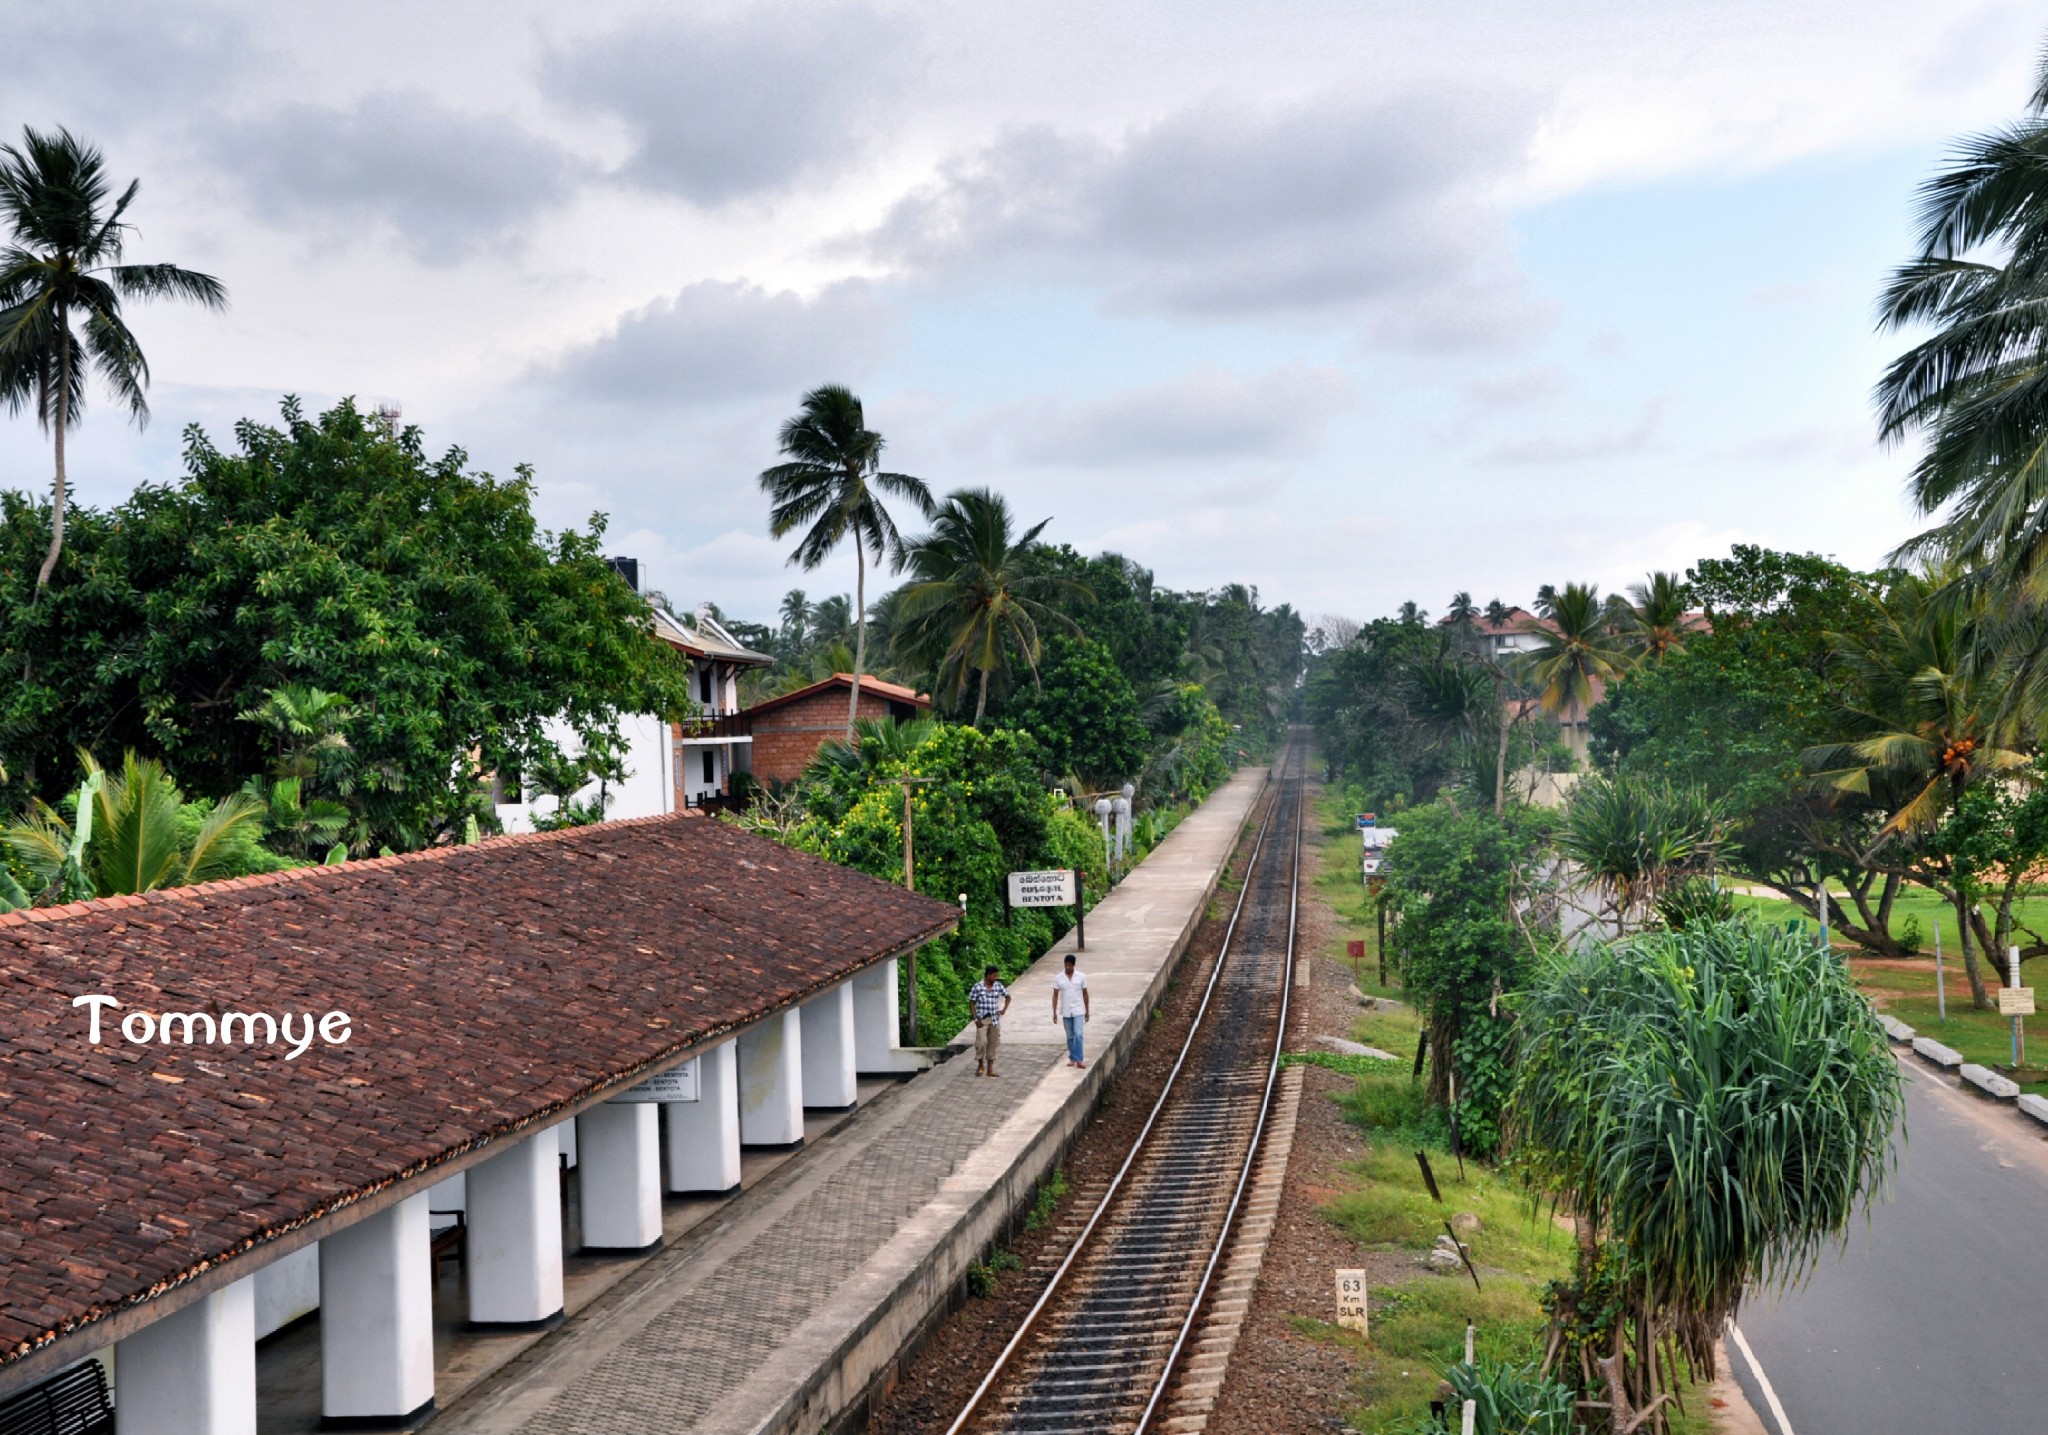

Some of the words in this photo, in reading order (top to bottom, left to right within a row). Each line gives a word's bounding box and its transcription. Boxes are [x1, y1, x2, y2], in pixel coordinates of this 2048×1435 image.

[1022, 895, 1063, 903] BENTOTA
[1343, 1280, 1361, 1292] 63
[1343, 1295, 1360, 1303] Km
[1340, 1306, 1365, 1317] SLR
